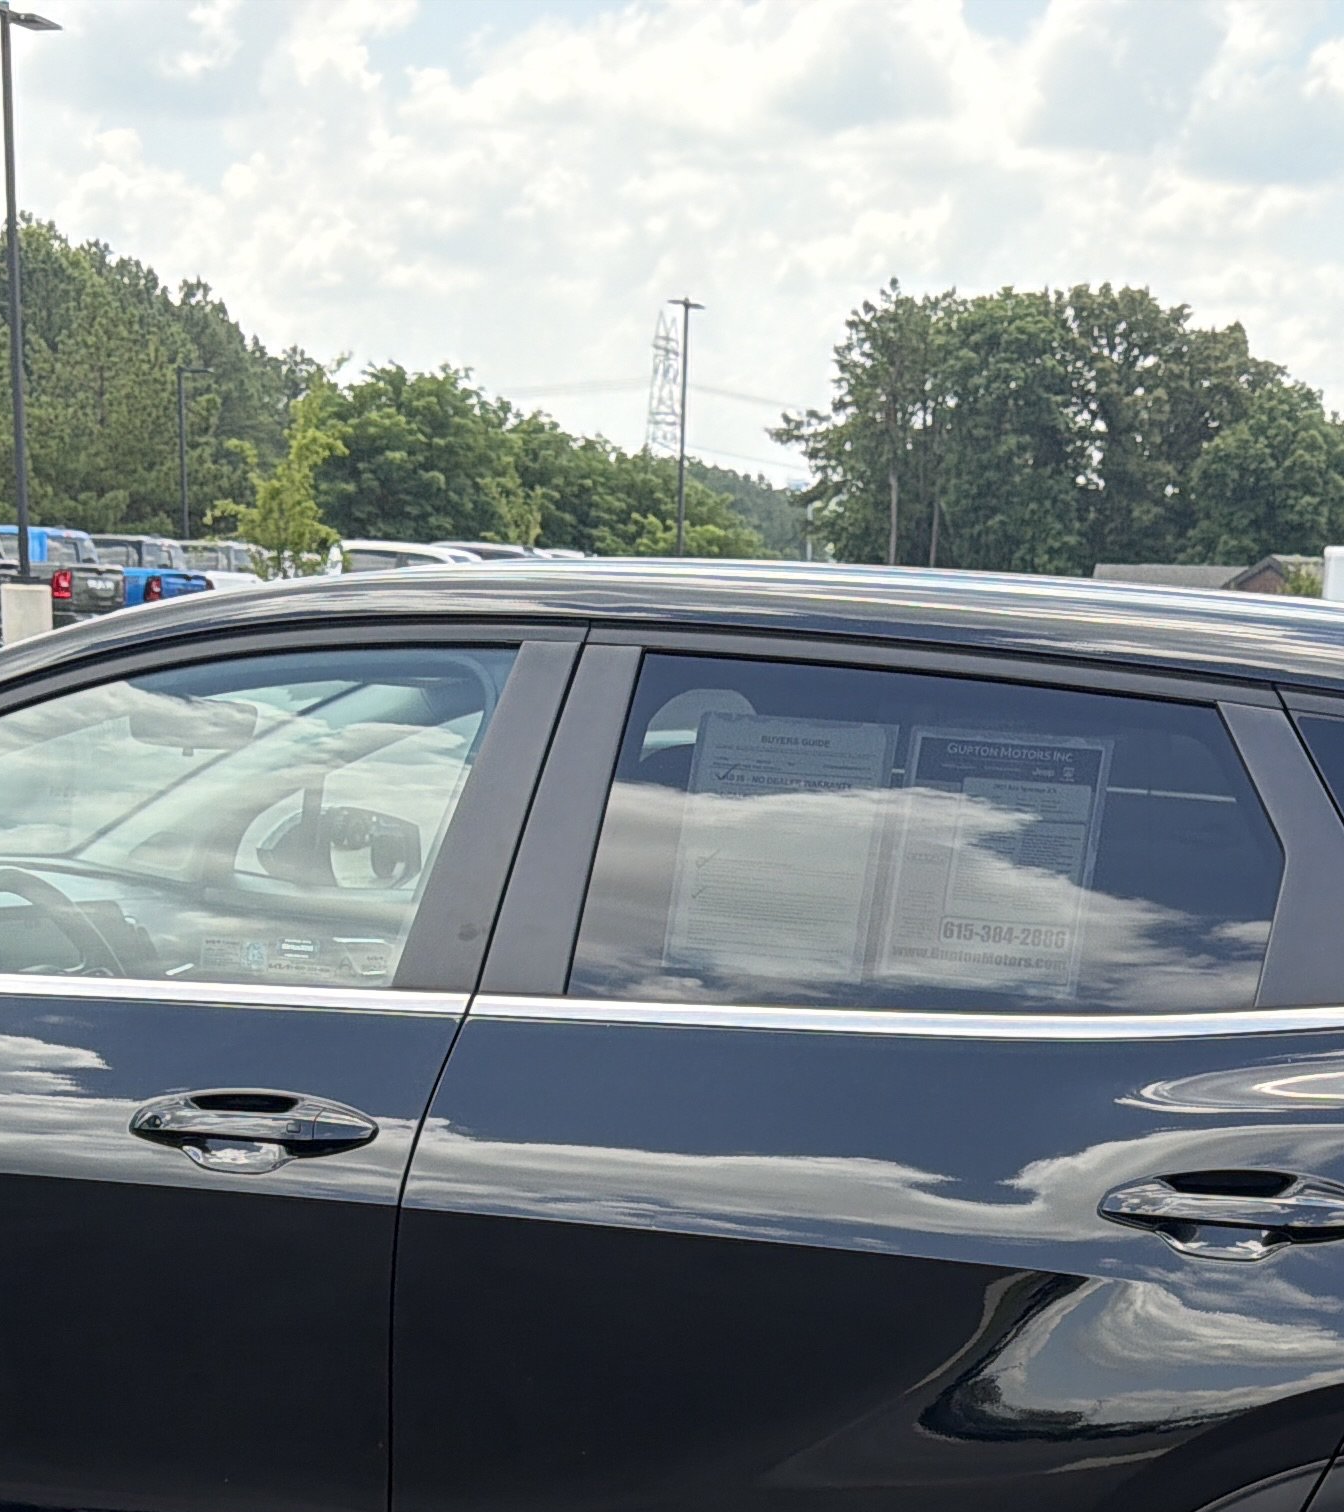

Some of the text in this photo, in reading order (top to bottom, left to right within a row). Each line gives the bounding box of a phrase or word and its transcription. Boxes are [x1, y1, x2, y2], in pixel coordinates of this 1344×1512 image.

[761, 735, 831, 749] BUYERS GUIDE
[999, 747, 1051, 760] MOTORS
[1052, 751, 1074, 763] INC
